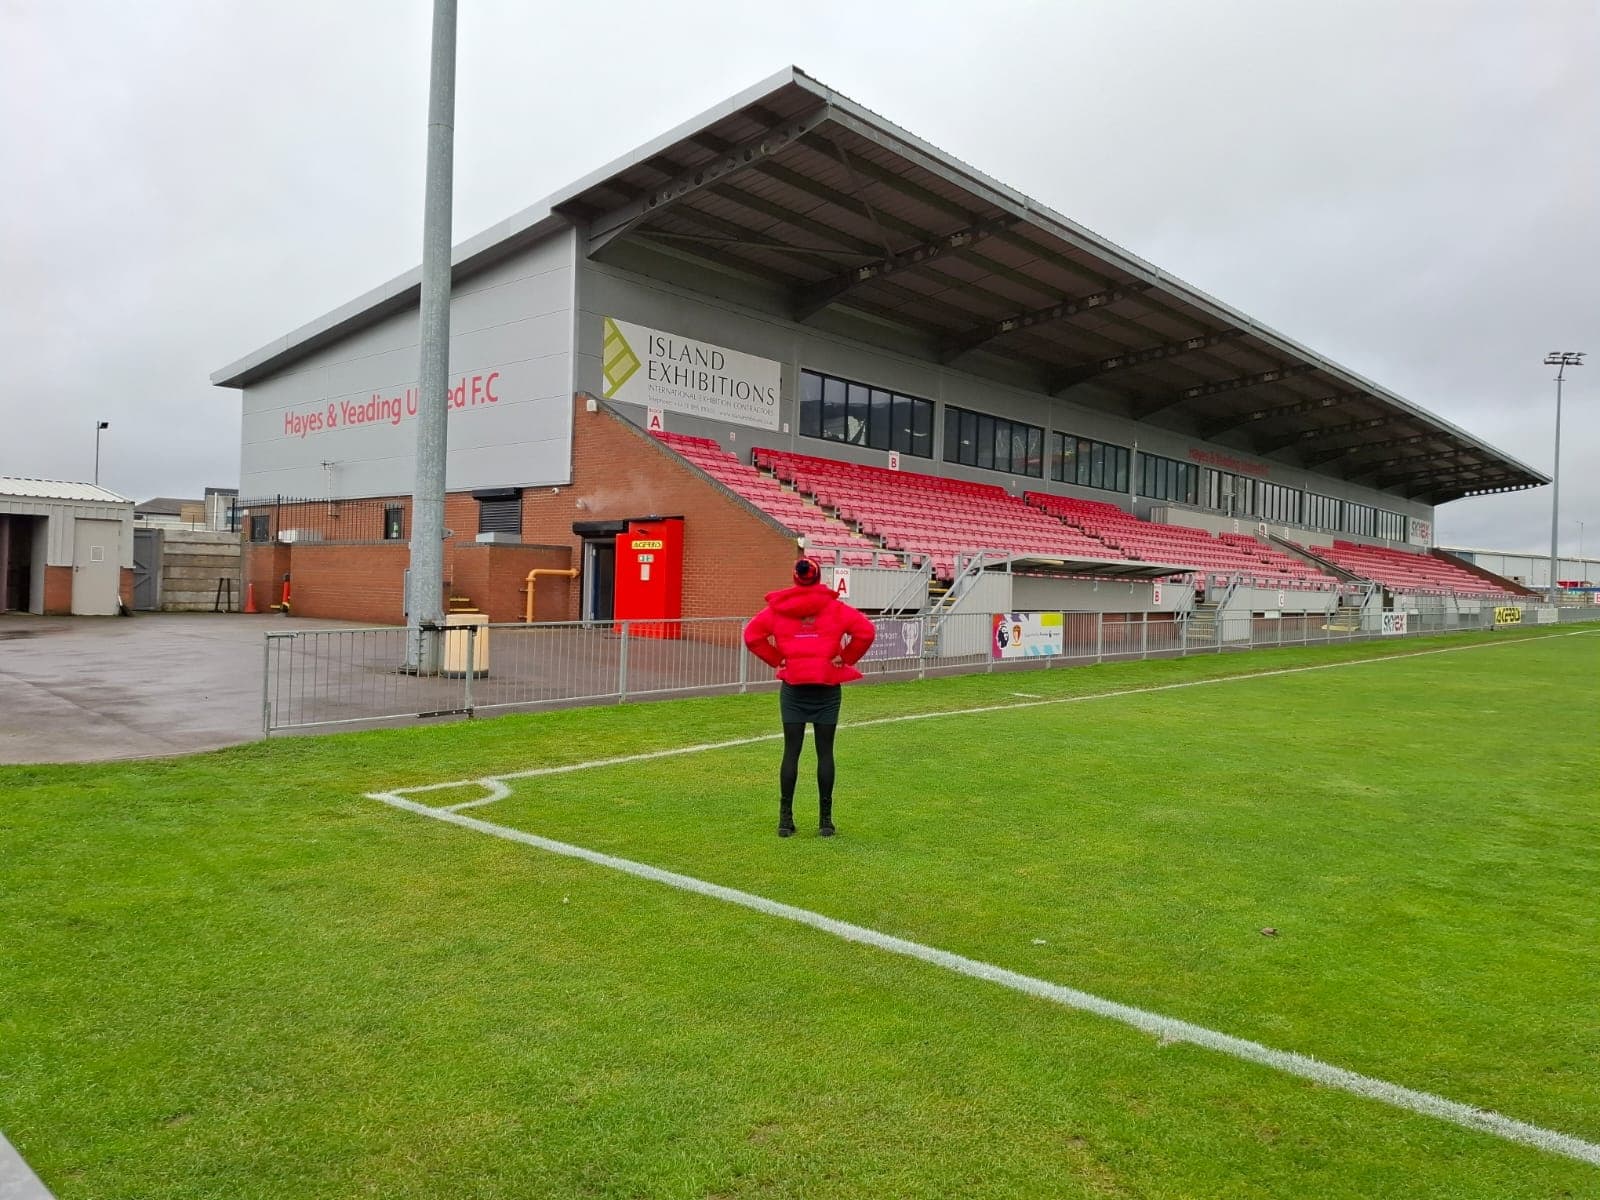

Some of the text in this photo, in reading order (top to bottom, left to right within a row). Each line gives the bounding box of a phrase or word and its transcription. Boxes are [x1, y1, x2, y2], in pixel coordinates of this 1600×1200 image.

[648, 335, 725, 371] ISLAND
[648, 360, 775, 406] EXHIBITIONS
[285, 411, 323, 439] Hayes
[326, 403, 338, 428] &
[341, 394, 402, 425] Yeading
[650, 415, 661, 429] A
[837, 577, 848, 594] A
